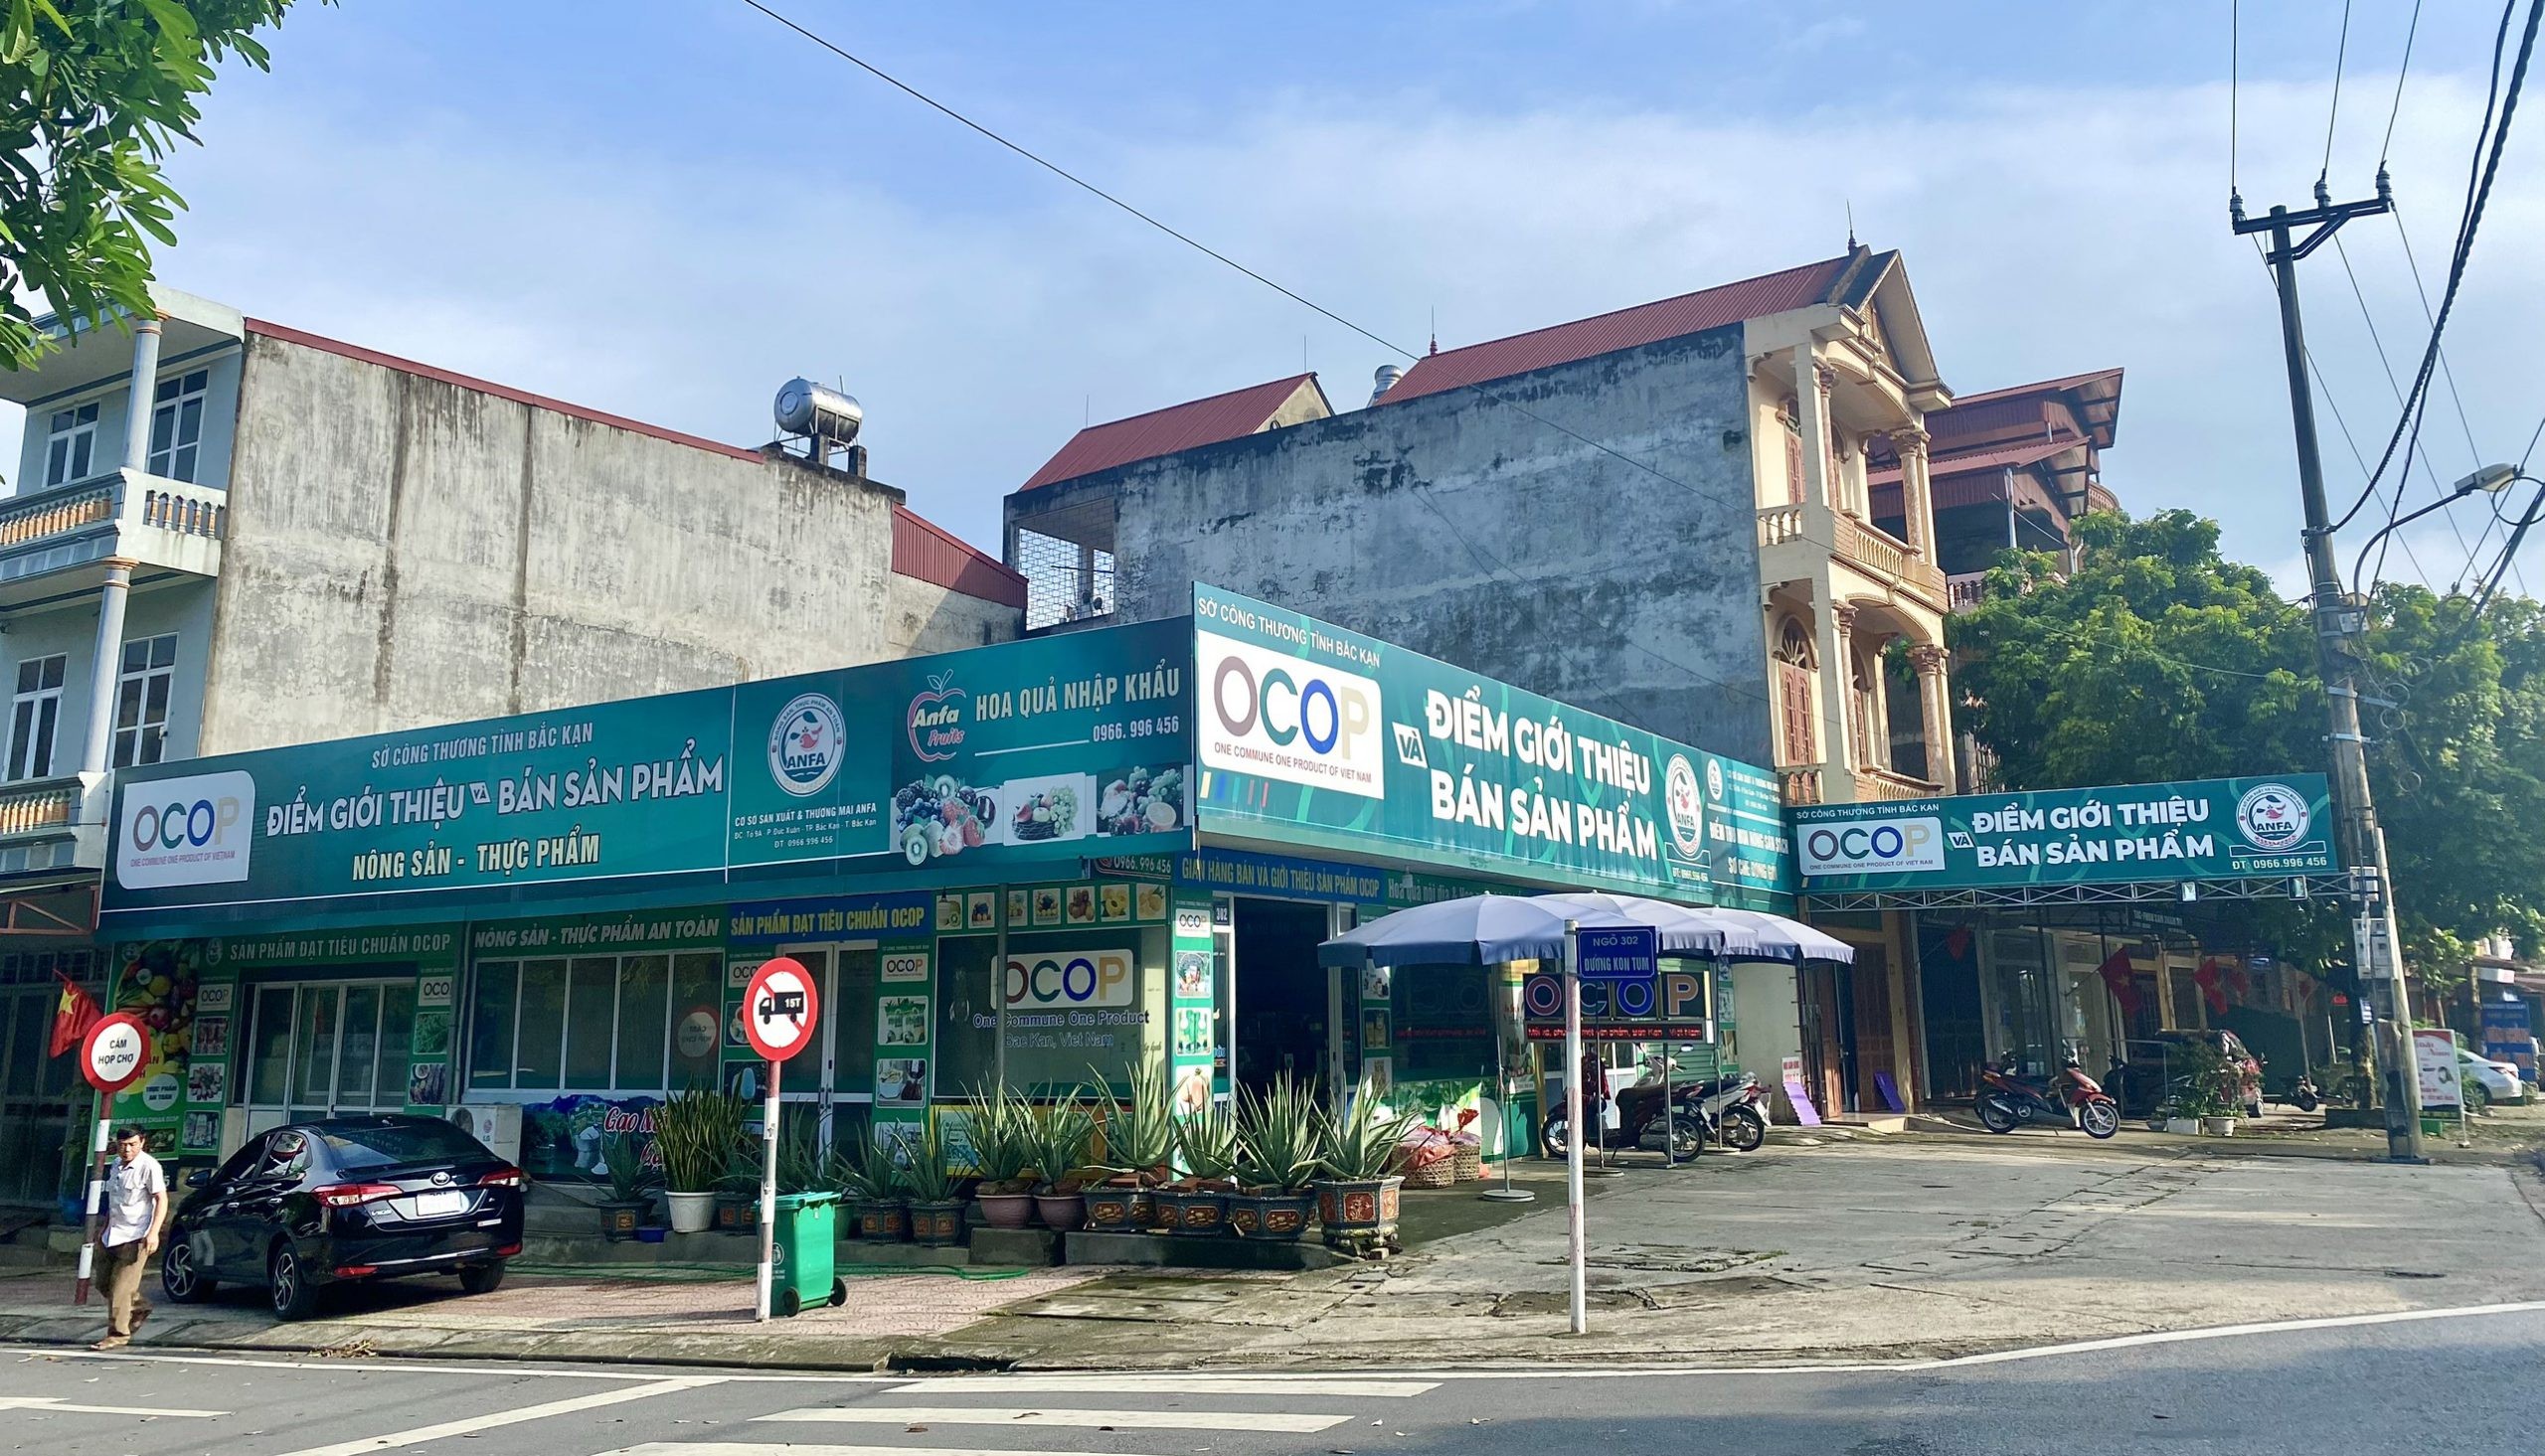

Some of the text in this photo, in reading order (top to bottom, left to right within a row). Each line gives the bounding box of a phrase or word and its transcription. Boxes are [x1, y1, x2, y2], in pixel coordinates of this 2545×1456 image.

[1199, 597, 1217, 617] SỞ
[1221, 604, 1256, 628] CÔNG
[1259, 615, 1307, 644] THƯƠNG
[1310, 629, 1333, 653] TỈNH
[1359, 648, 1380, 669] KẠN
[976, 659, 1180, 722] HOA QUẢ NHẬP KHẨU
[911, 705, 959, 728] Anfa
[1214, 656, 1369, 760] OCOP
[928, 728, 965, 746] Fruits
[1094, 716, 1179, 742] 0966. 996 456
[1425, 685, 1651, 799] ĐIỂM GIỚI THIỆU
[371, 722, 594, 769] SỞ CÔNG THƯƠNG TỈNH BẮC KẠN
[1399, 730, 1423, 761] VÀ
[786, 752, 825, 768] ANFA
[1214, 741, 1372, 783] ONE COMMUNE ONE PRODUCT OF VIET NAM
[265, 785, 324, 836] ĐIỂM
[330, 785, 382, 830] GIỚI
[390, 777, 465, 830] THIỆU
[497, 766, 555, 814] BÁN
[563, 757, 622, 807] SẢN
[631, 738, 723, 799] PHẨM
[133, 796, 240, 852] OCOP
[796, 810, 803, 820] &
[856, 802, 877, 814] ANFA
[1431, 763, 1657, 861] BÁN SẢN PHẨM
[1677, 813, 1695, 828] ANFA
[1796, 810, 1809, 819] SỞ
[1811, 808, 1835, 818] CÔNG
[1837, 807, 1875, 817] THƯƠNG
[1920, 802, 1939, 813] KẠN
[1972, 795, 2209, 833] ĐIỂM GIỚI THIỆU
[1952, 831, 1970, 846] VÀ
[2256, 821, 2292, 831] ANFA
[352, 848, 405, 881] NÔNG
[411, 840, 450, 877] SẢN
[477, 837, 529, 873] THỰC
[536, 824, 599, 868] PHẨM
[1808, 825, 1931, 861] OCOP
[1977, 828, 2215, 867] BÁN SẢN PHẨM
[1140, 857, 1154, 872] 996
[1156, 860, 1171, 874] 456
[2253, 858, 2303, 869] 0966.996
[2306, 857, 2327, 866] 456
[1208, 857, 1234, 882] HÀNG
[1237, 863, 1255, 885] BÁN
[1257, 863, 1269, 887] VÀ
[1272, 865, 1288, 889] GIỚI
[1290, 867, 1314, 896] THIỆU
[1317, 868, 1333, 892] SẢN
[1335, 868, 1358, 895] PHẨM
[1359, 879, 1380, 898] OCOP
[731, 903, 925, 936] SẢN PHẨM ĐẠT TIÊU CHUẨN OCOP
[1179, 913, 1206, 928] OCOP
[1216, 907, 1228, 921] 302
[230, 930, 450, 960] SẢN PHẨM ĐẠT TIÊU CHUẨN OCOP
[475, 914, 719, 948] NÔNG SẢN THỰC PHẨM AN TOÀN
[1593, 933, 1638, 946] NGÕ 302
[887, 960, 923, 973] OCOP
[1584, 954, 1649, 971] ĐƯỜNG KON TUM
[1004, 957, 1127, 1003] OCOP
[784, 998, 801, 1008] 15T
[1525, 974, 1699, 1017] OCOP
[973, 1013, 997, 1029] One
[1069, 1011, 1095, 1026] One
[1098, 1010, 1150, 1025] Product
[1087, 1033, 1113, 1047] Nam
[98, 1053, 134, 1066] HỌP CHỢ
